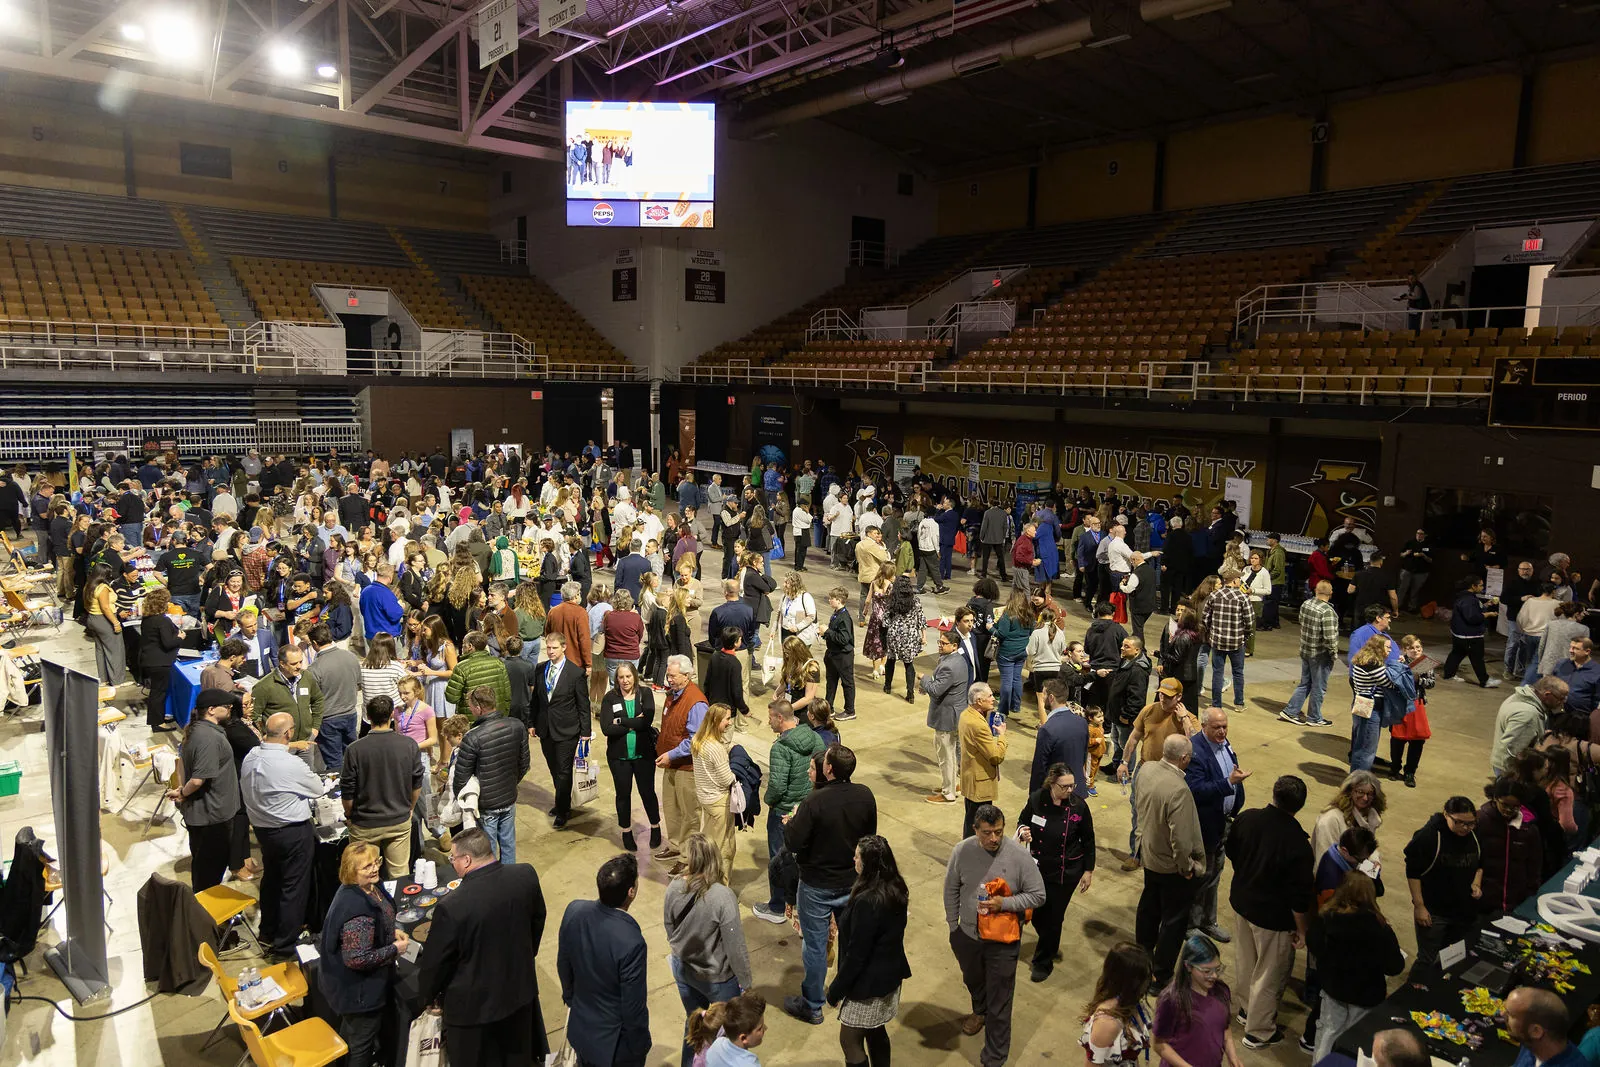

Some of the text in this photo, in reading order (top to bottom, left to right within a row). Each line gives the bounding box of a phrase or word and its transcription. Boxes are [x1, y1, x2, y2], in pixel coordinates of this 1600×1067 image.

[494, 20, 501, 42] 21
[32, 126, 44, 141] 5
[1311, 125, 1328, 142] 10
[277, 160, 288, 173] 6
[1108, 162, 1119, 175] 9
[439, 181, 448, 193] 7
[968, 184, 978, 197] 8
[1524, 240, 1539, 250] EXIT
[700, 271, 711, 282] 28
[387, 322, 402, 376] 3
[1557, 393, 1588, 401] PERIOD
[896, 457, 916, 465] TPEI
[962, 438, 1257, 490] LEHIGH UNIVERSITY
